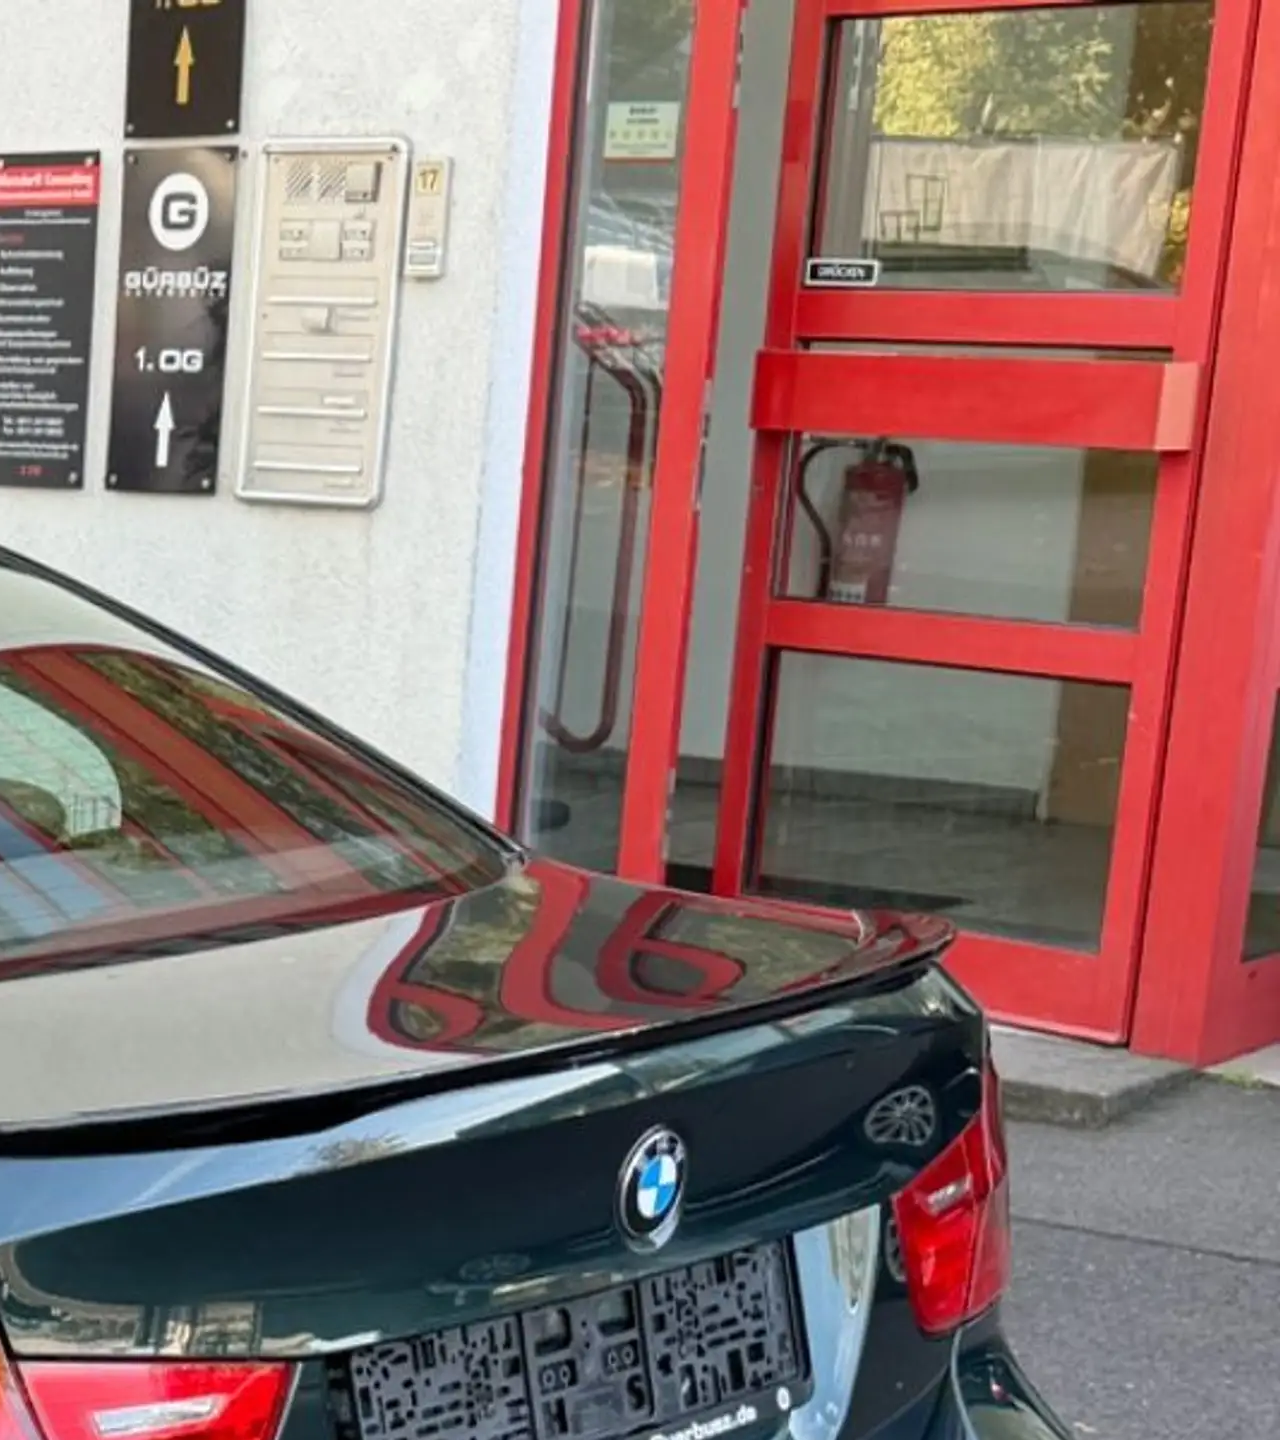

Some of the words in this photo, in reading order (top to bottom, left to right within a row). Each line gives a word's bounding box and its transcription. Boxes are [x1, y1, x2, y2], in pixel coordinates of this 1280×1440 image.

[161, 191, 197, 230] G
[125, 266, 227, 290] GÜRBÜZ
[135, 346, 155, 373] 1.
[159, 350, 204, 373] OG
